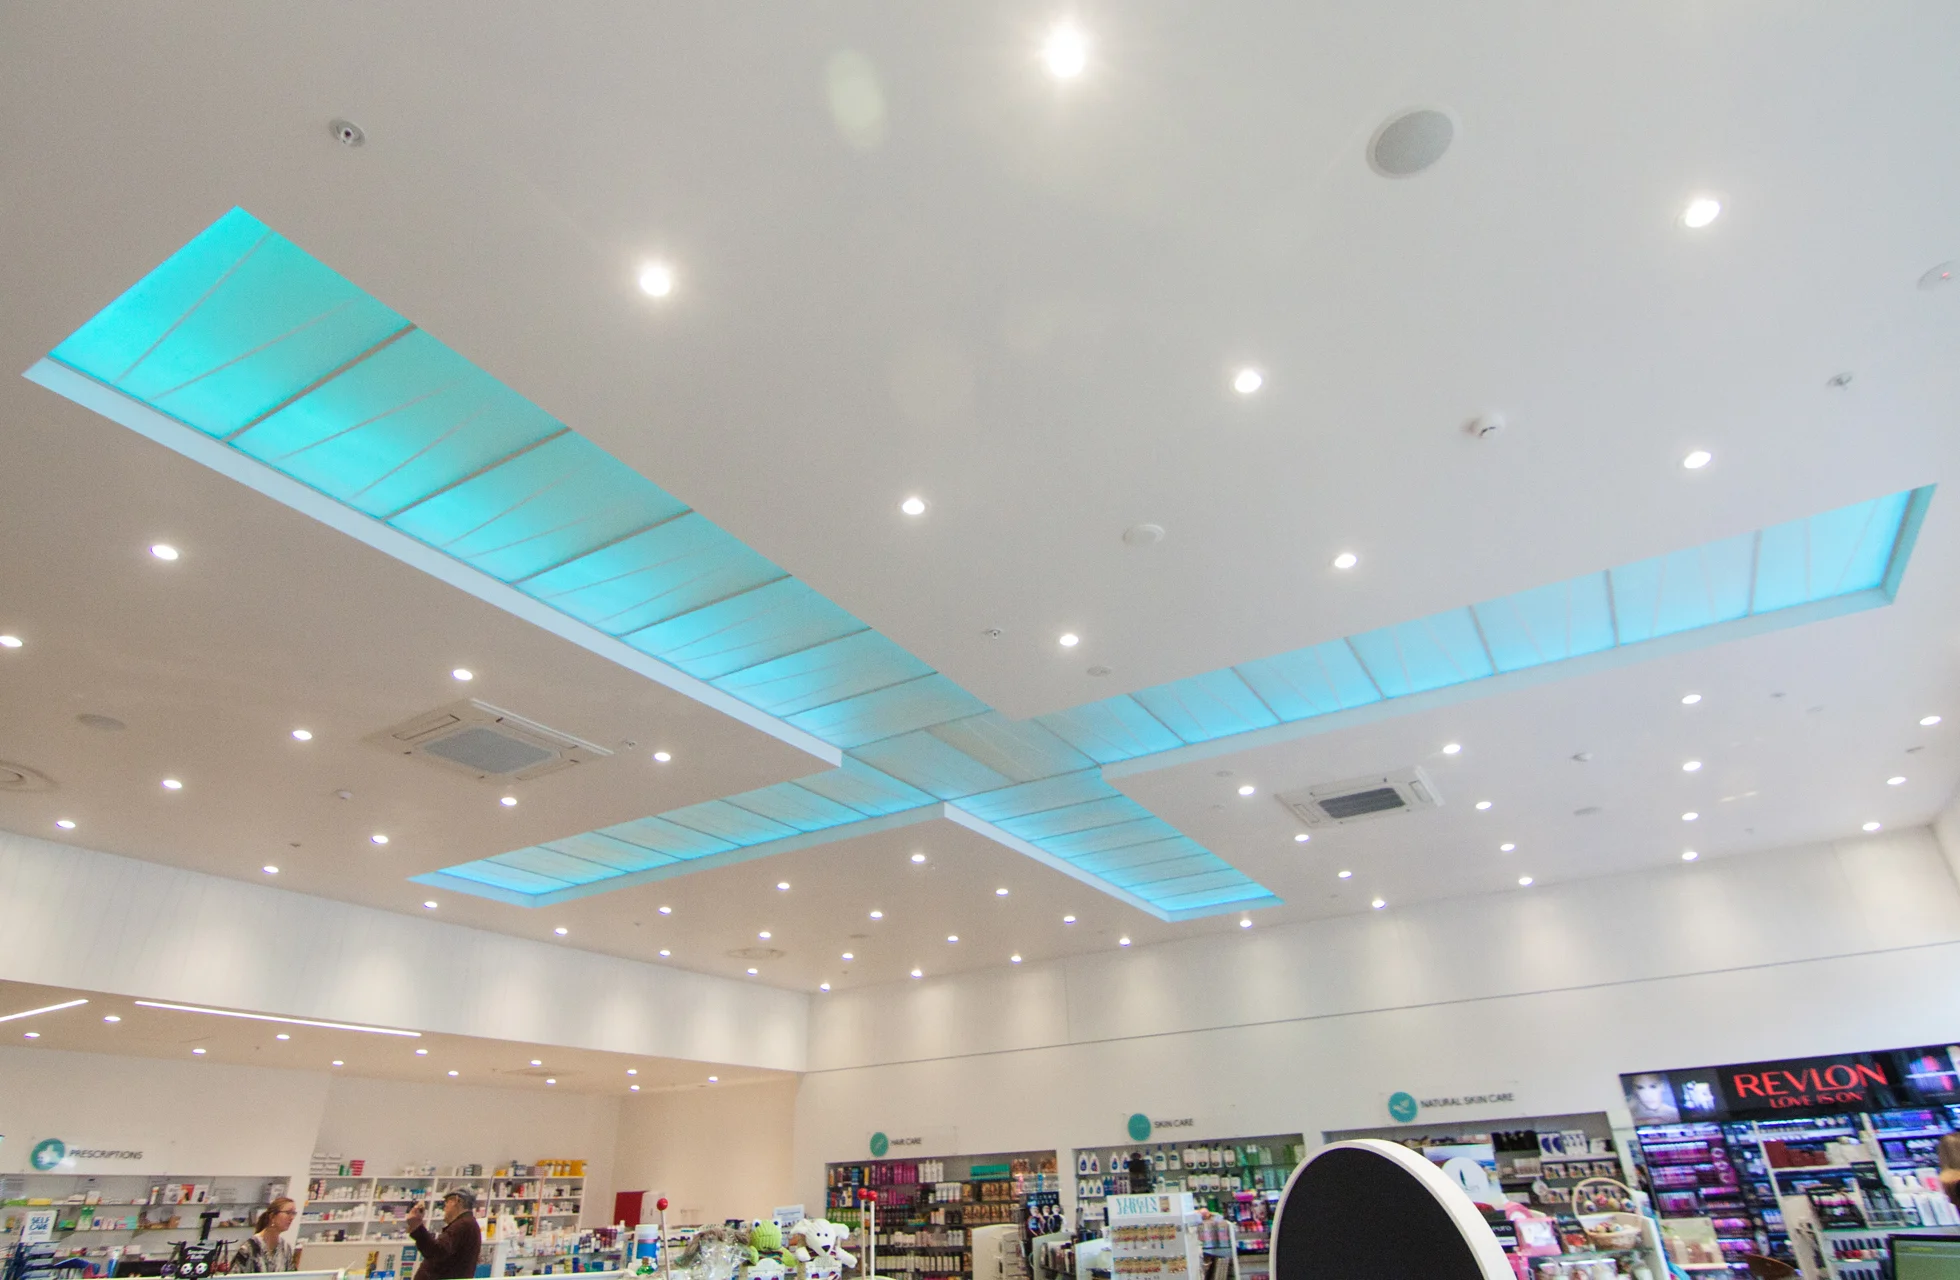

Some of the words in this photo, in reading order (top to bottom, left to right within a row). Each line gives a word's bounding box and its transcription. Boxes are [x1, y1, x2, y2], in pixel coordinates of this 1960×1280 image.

[1733, 1062, 1889, 1099] REVLON
[1420, 1098, 1462, 1108] NATURAL
[1463, 1096, 1488, 1105] SKIN
[1489, 1093, 1515, 1103] CARE
[1769, 1094, 1813, 1109] LOVE
[1816, 1093, 1835, 1105] IS
[1835, 1091, 1867, 1104] ON
[1154, 1120, 1173, 1128] SKIN
[1173, 1118, 1194, 1127] CARE
[905, 1136, 922, 1145] CARE
[69, 1149, 143, 1160] PRESCRIPTIONS
[1116, 1196, 1157, 1207] VIRGIN
[1117, 1204, 1158, 1215] JEWELS
[29, 1223, 49, 1231] CARE
